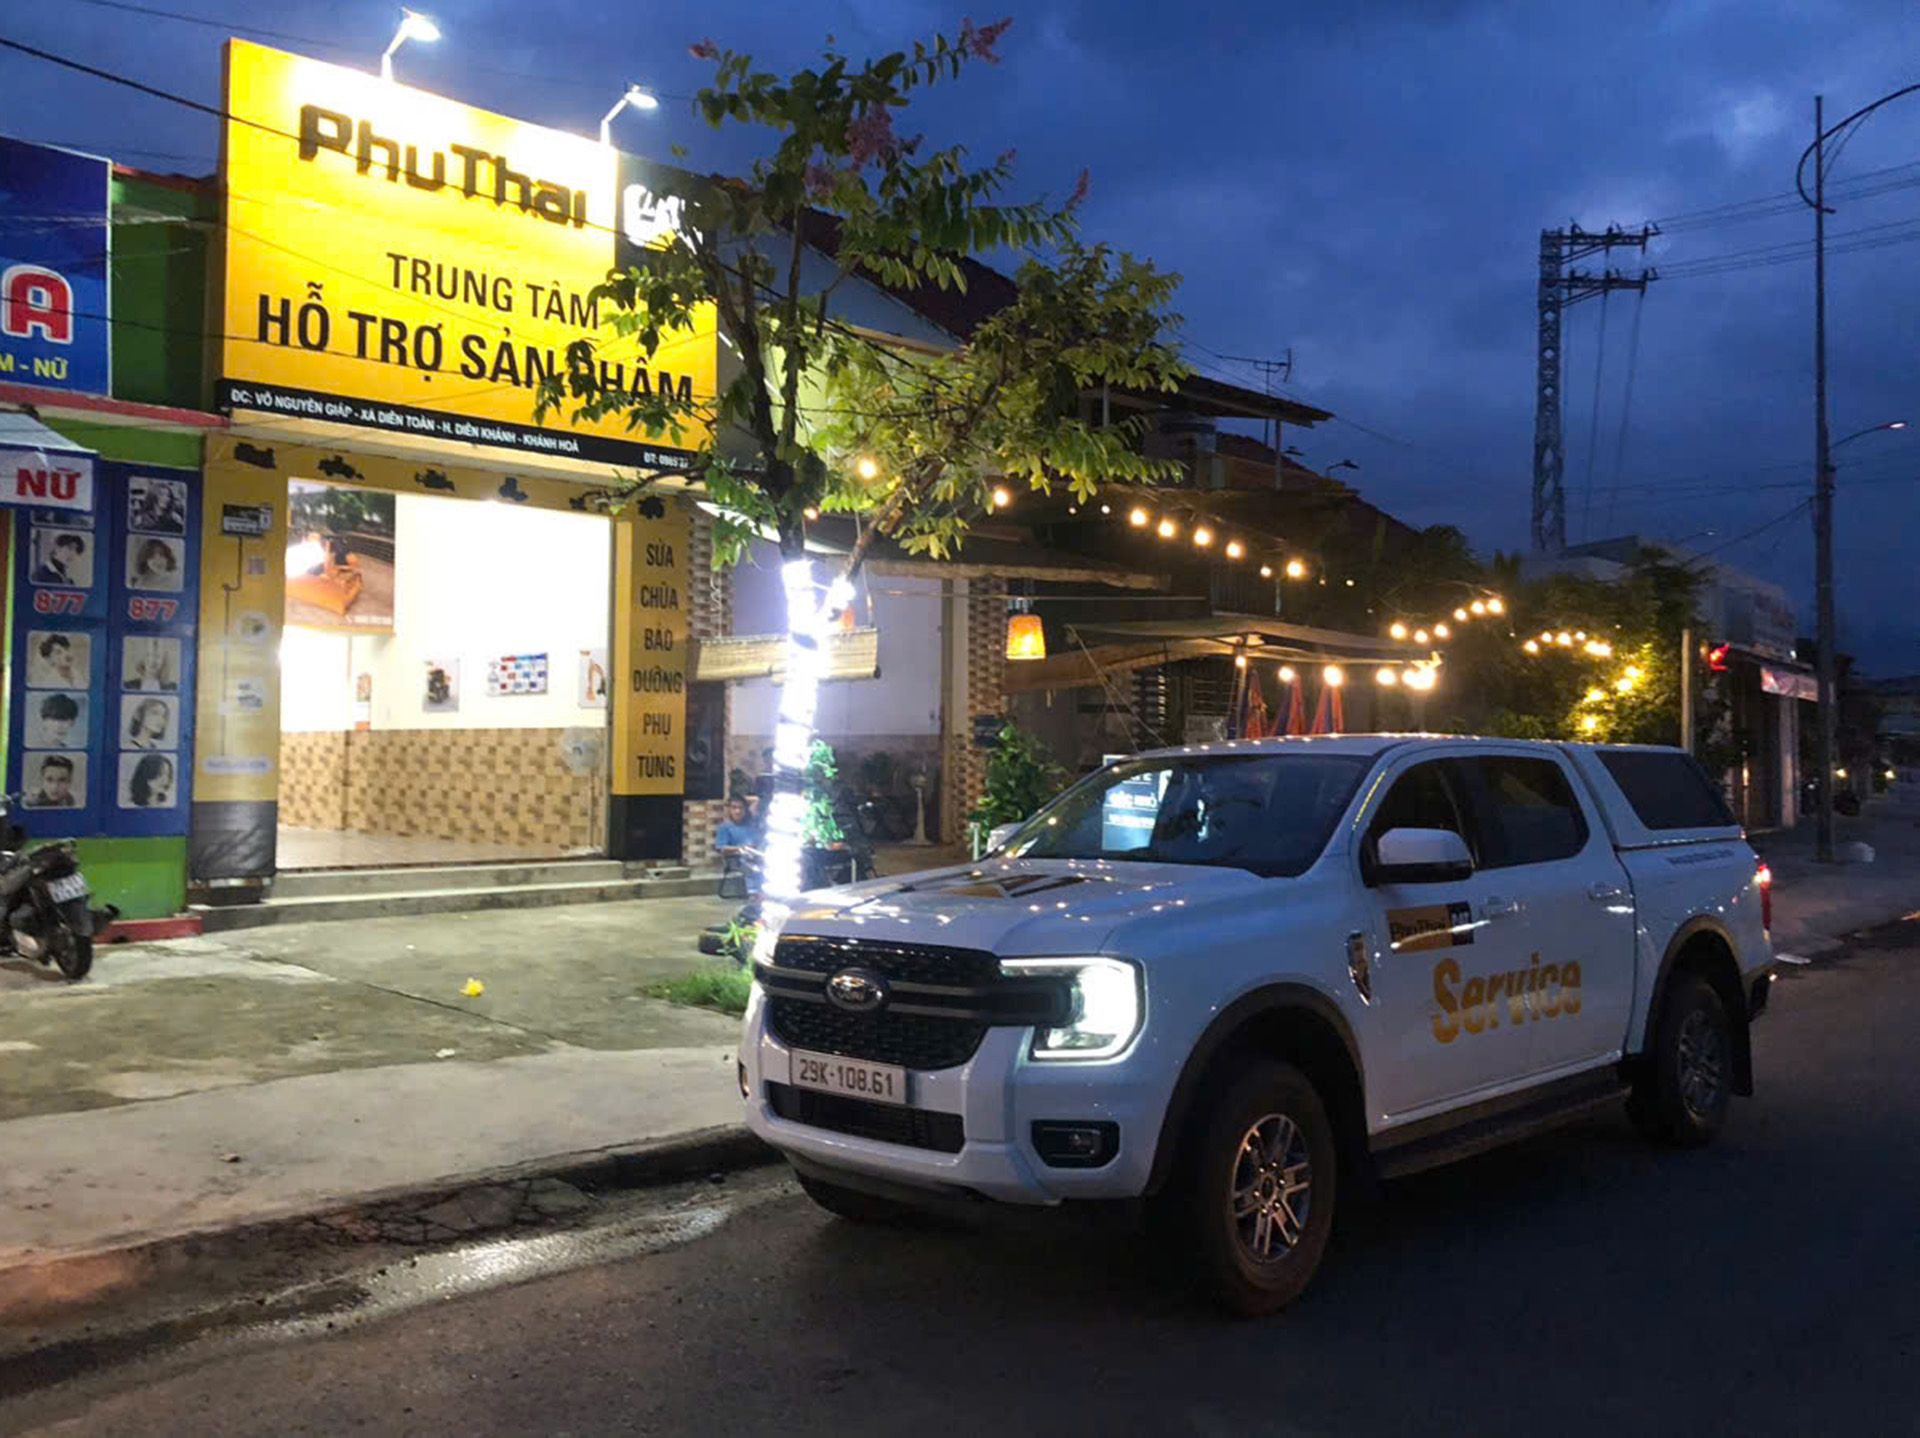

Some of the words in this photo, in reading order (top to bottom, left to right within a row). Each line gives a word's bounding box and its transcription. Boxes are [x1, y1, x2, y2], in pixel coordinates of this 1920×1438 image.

[299, 103, 587, 229] PhuThai
[387, 252, 513, 313] TRUNG
[526, 279, 600, 330] TÂM
[258, 281, 330, 353] HỖ
[348, 311, 444, 383] TRỢ
[460, 327, 555, 391] SẢN
[33, 356, 69, 380] NỮ
[16, 466, 82, 500] NỮ
[33, 589, 87, 614] 877
[128, 596, 179, 621] 877
[643, 712, 672, 742] PHỤ
[1431, 952, 1582, 1044] Service
[799, 1057, 894, 1097] 29K-108.61
